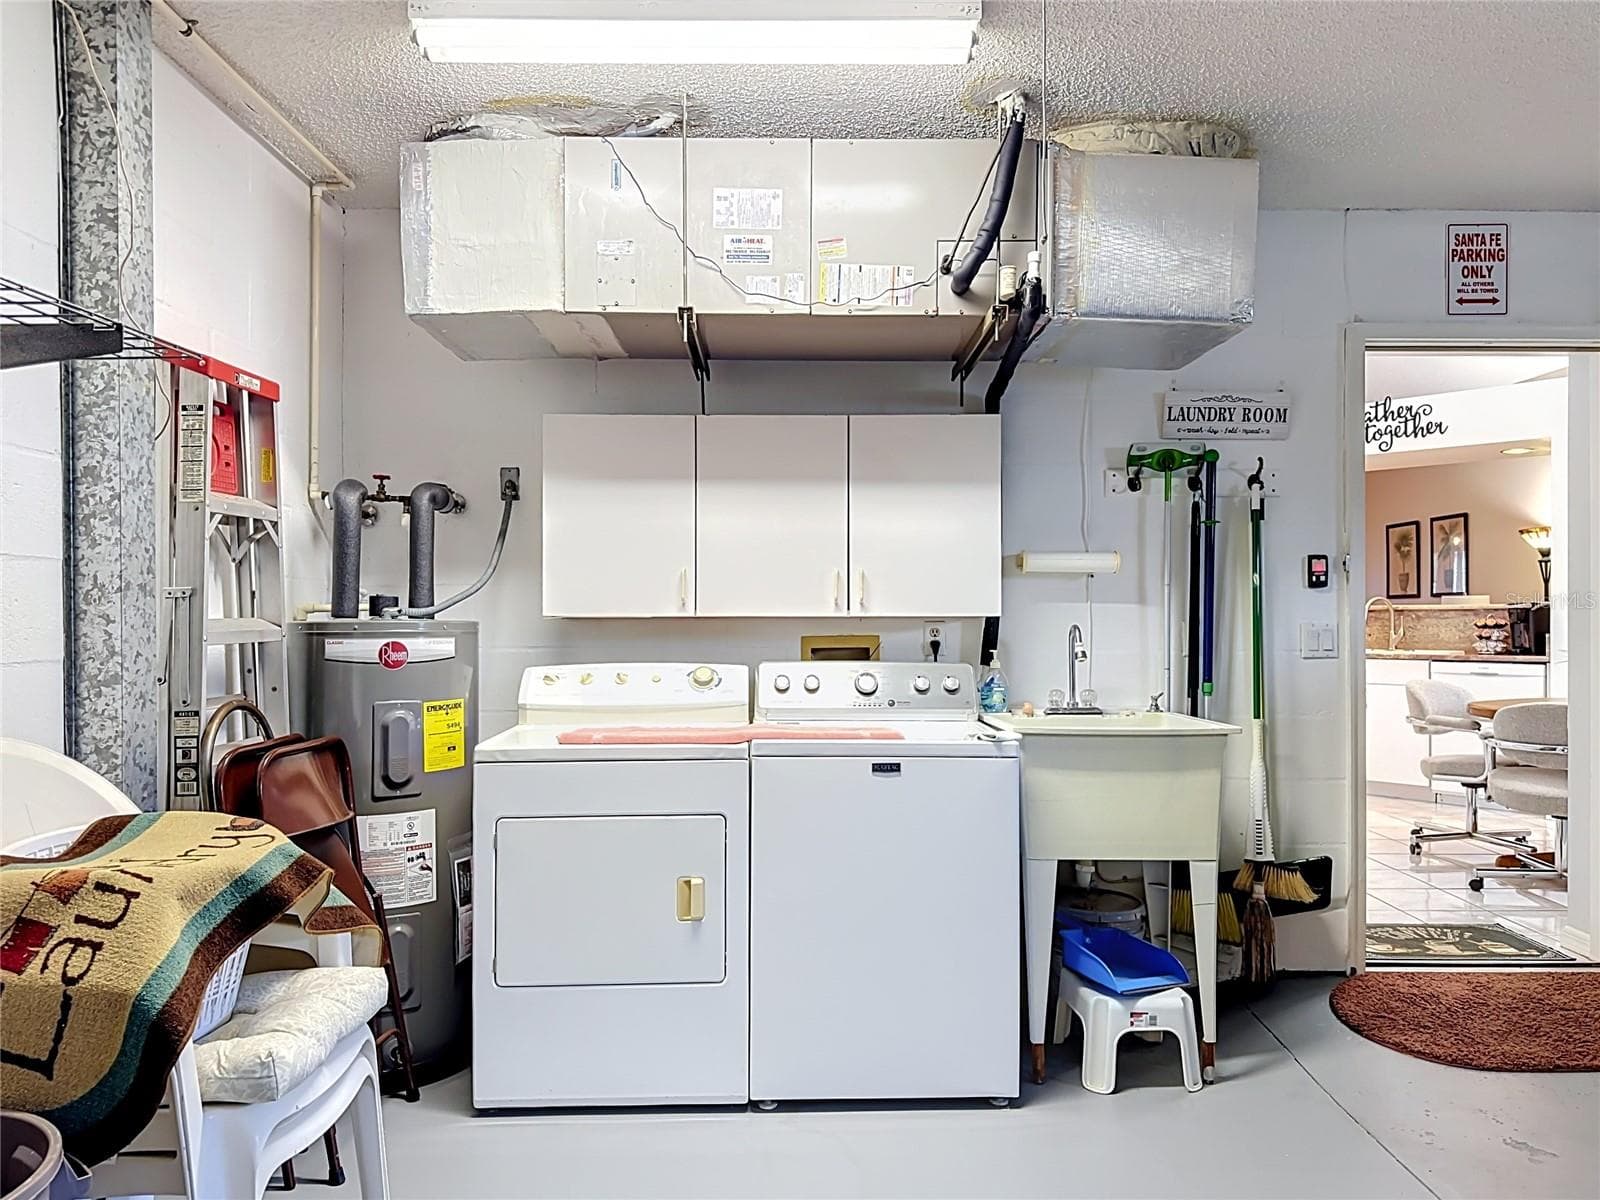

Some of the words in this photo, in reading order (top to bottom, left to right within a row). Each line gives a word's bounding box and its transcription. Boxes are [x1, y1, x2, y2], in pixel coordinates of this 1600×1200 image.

[1454, 233, 1487, 247] SANTA
[1489, 233, 1502, 247] FE
[1451, 248, 1506, 262] PARKING
[1461, 265, 1494, 279] ONLY
[1167, 406, 1237, 422] LAUNDRY
[1242, 407, 1288, 423] ROOM
[1364, 396, 1433, 423] ather
[1365, 410, 1449, 452] together
[382, 642, 408, 665] Rheem
